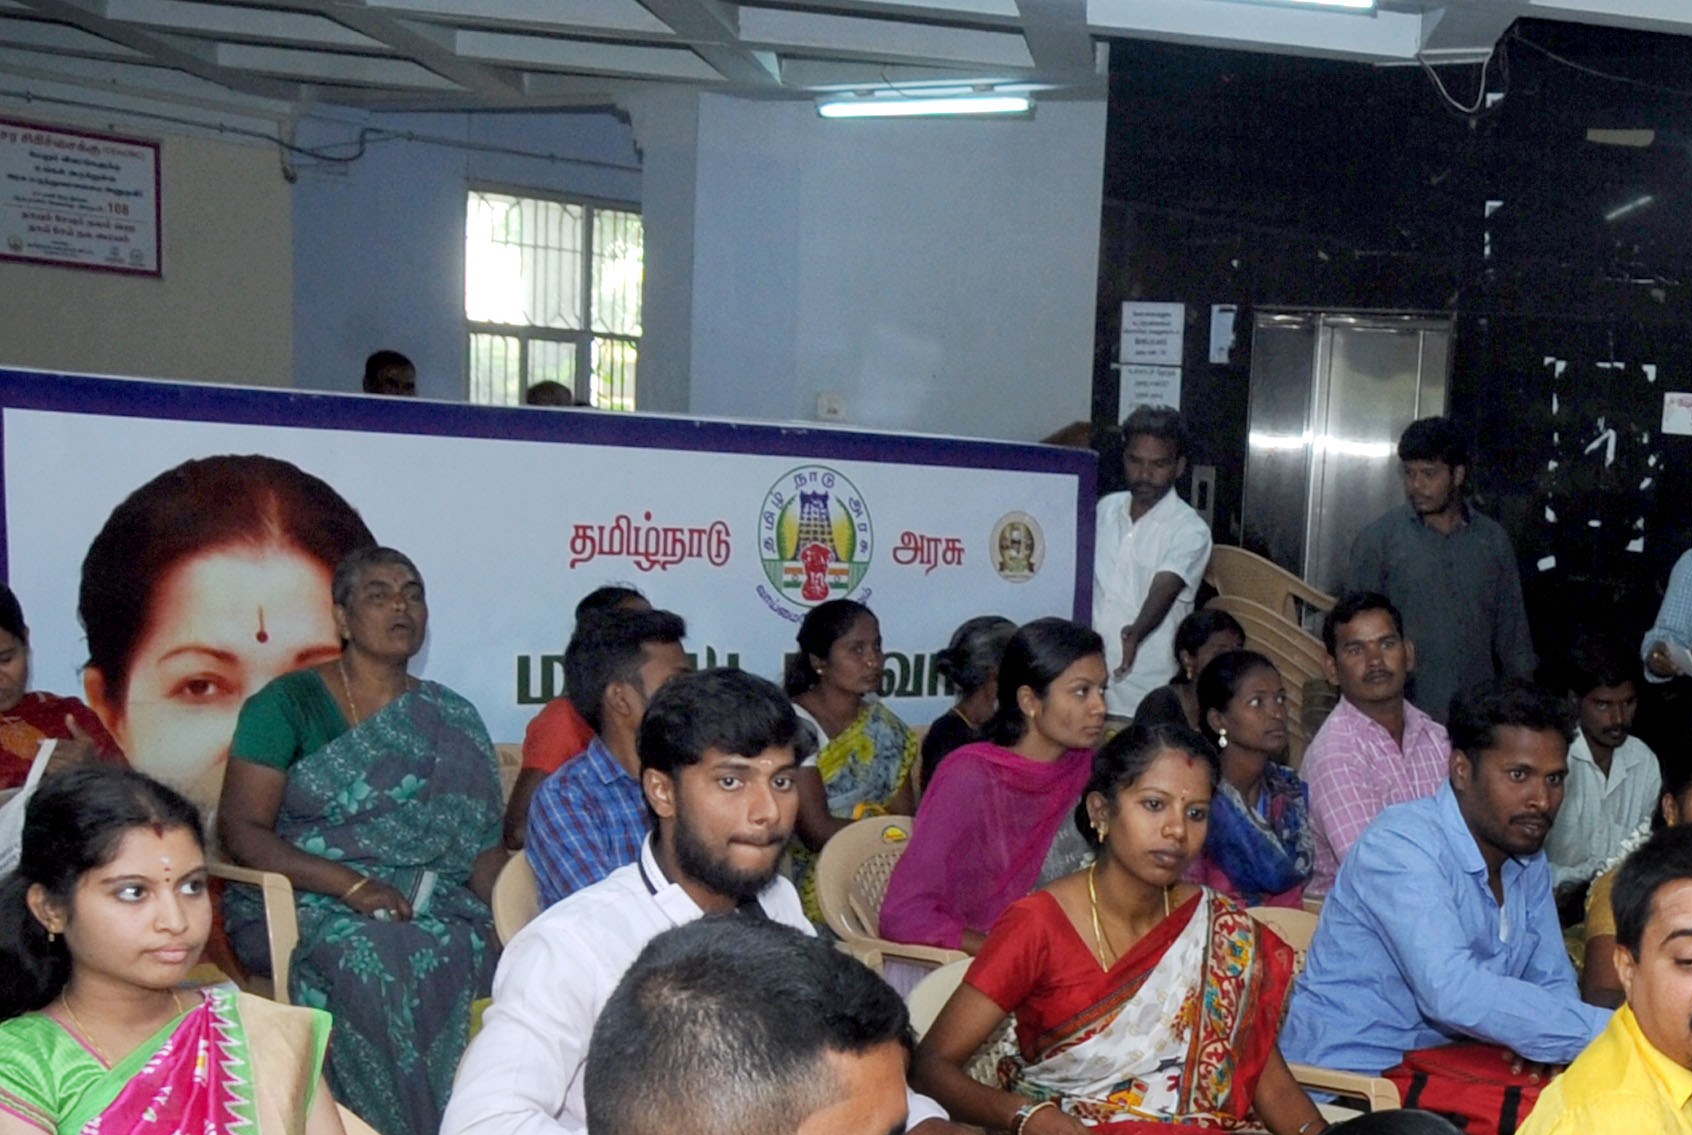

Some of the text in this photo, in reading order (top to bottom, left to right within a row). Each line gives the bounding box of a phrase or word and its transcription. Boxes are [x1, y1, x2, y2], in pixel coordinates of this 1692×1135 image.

[107, 201, 129, 216] 108
[569, 510, 966, 576] தமிழ்நாடு அரசு
